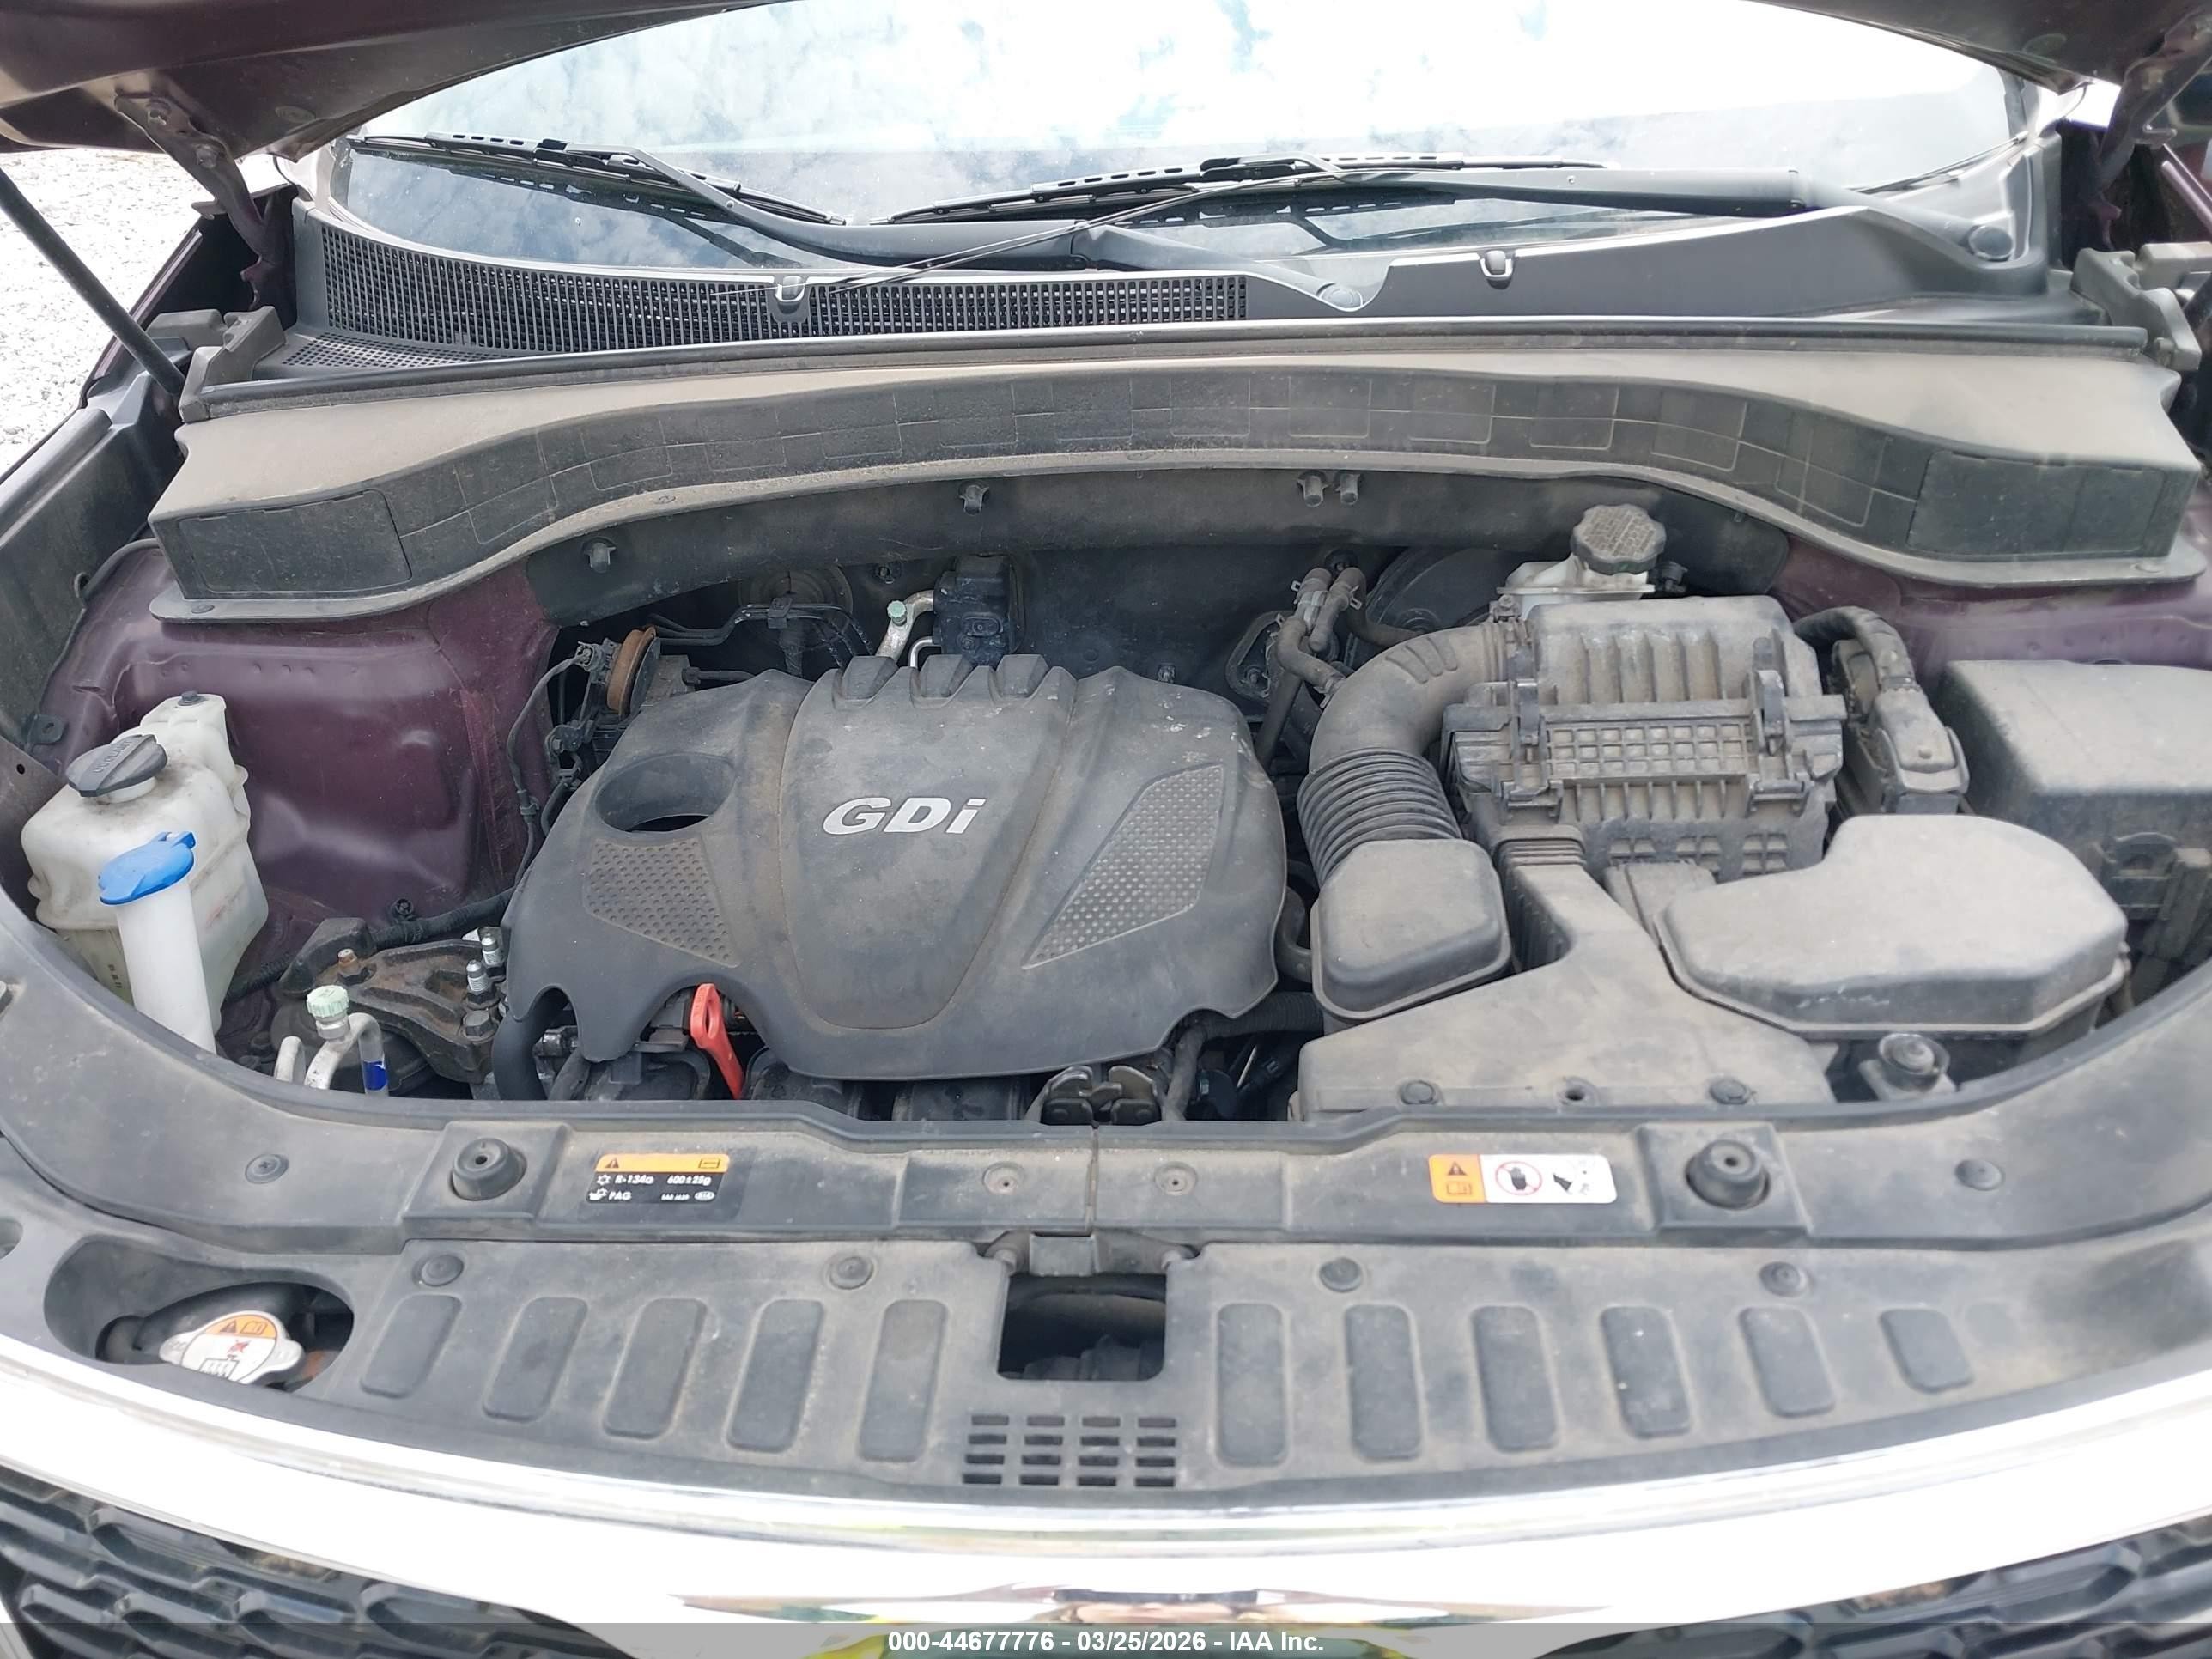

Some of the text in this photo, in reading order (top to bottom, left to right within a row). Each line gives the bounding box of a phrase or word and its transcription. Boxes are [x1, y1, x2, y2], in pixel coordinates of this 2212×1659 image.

[823, 797, 986, 835] GDi
[615, 1174, 654, 1185] R-134a
[609, 1191, 633, 1200] PAG
